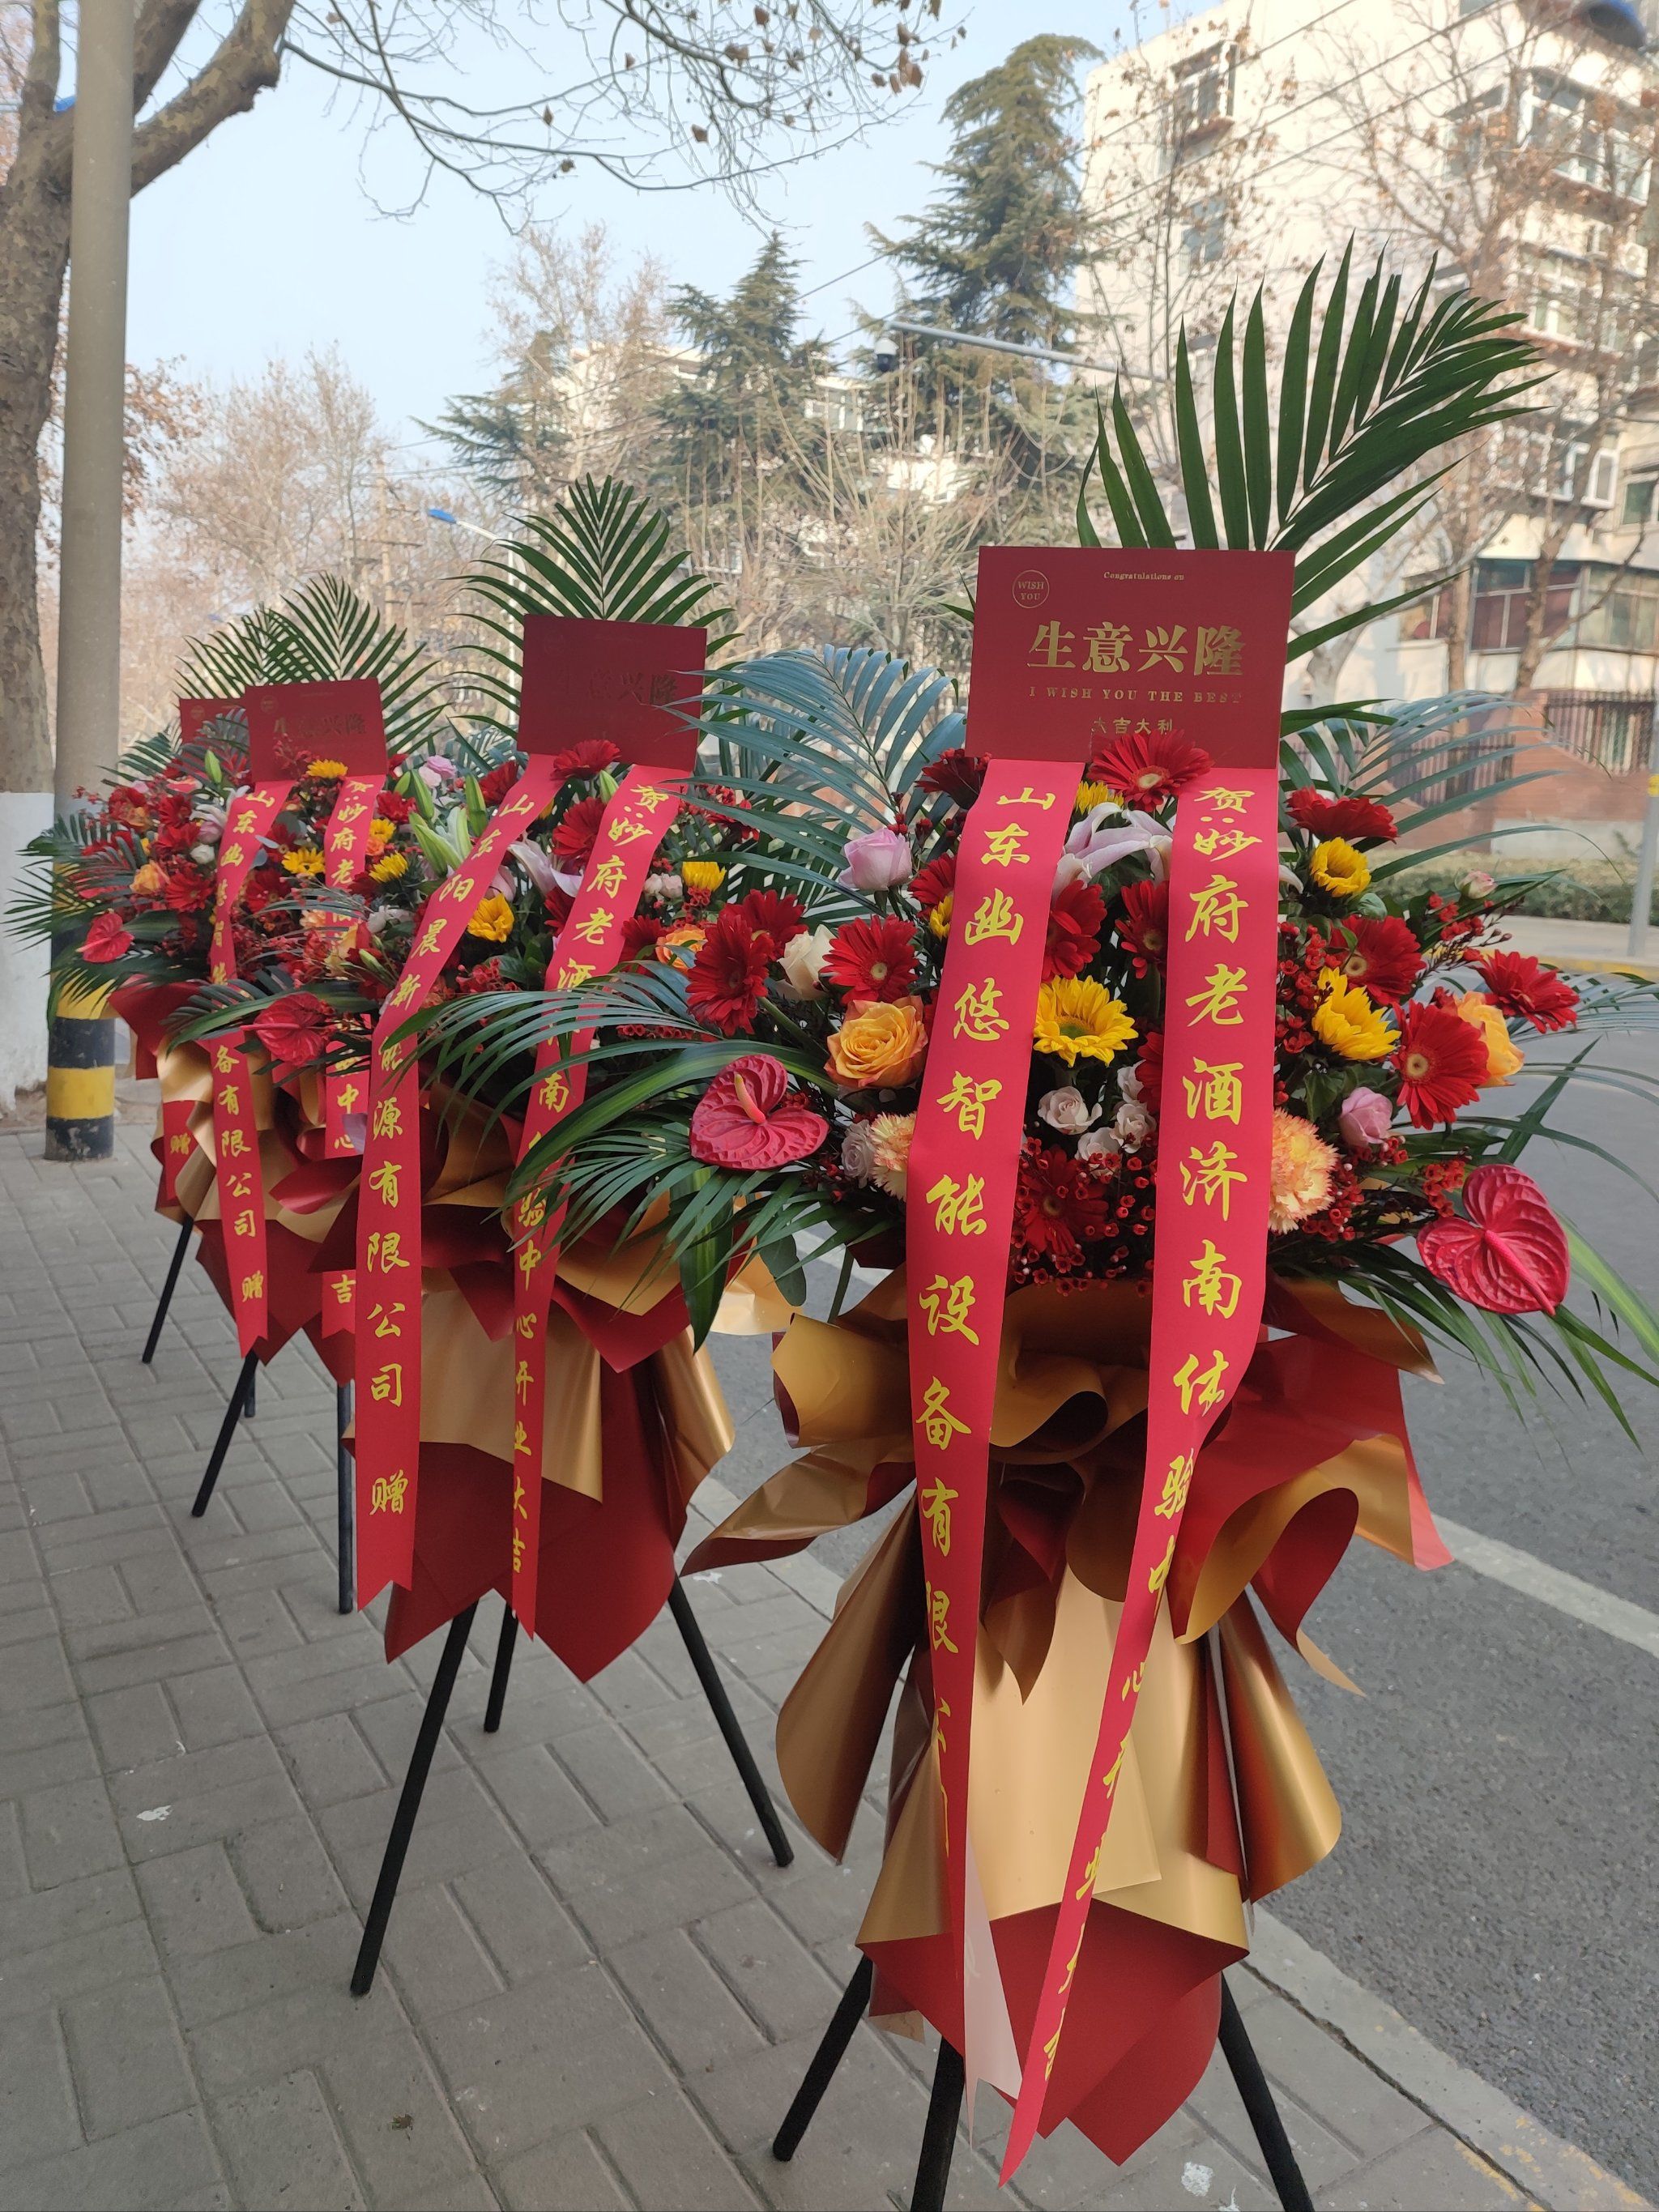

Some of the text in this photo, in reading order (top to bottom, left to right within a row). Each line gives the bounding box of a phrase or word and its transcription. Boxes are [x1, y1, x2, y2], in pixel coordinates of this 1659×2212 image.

[1103, 572, 1172, 581] Congratulations
[1017, 581, 1045, 590] WISH
[1020, 593, 1042, 601] YOU
[1026, 620, 1247, 676] 生意兴隆
[1029, 687, 1243, 703] I WISH YOU THE BEST
[1094, 717, 1173, 735] 大吉大利
